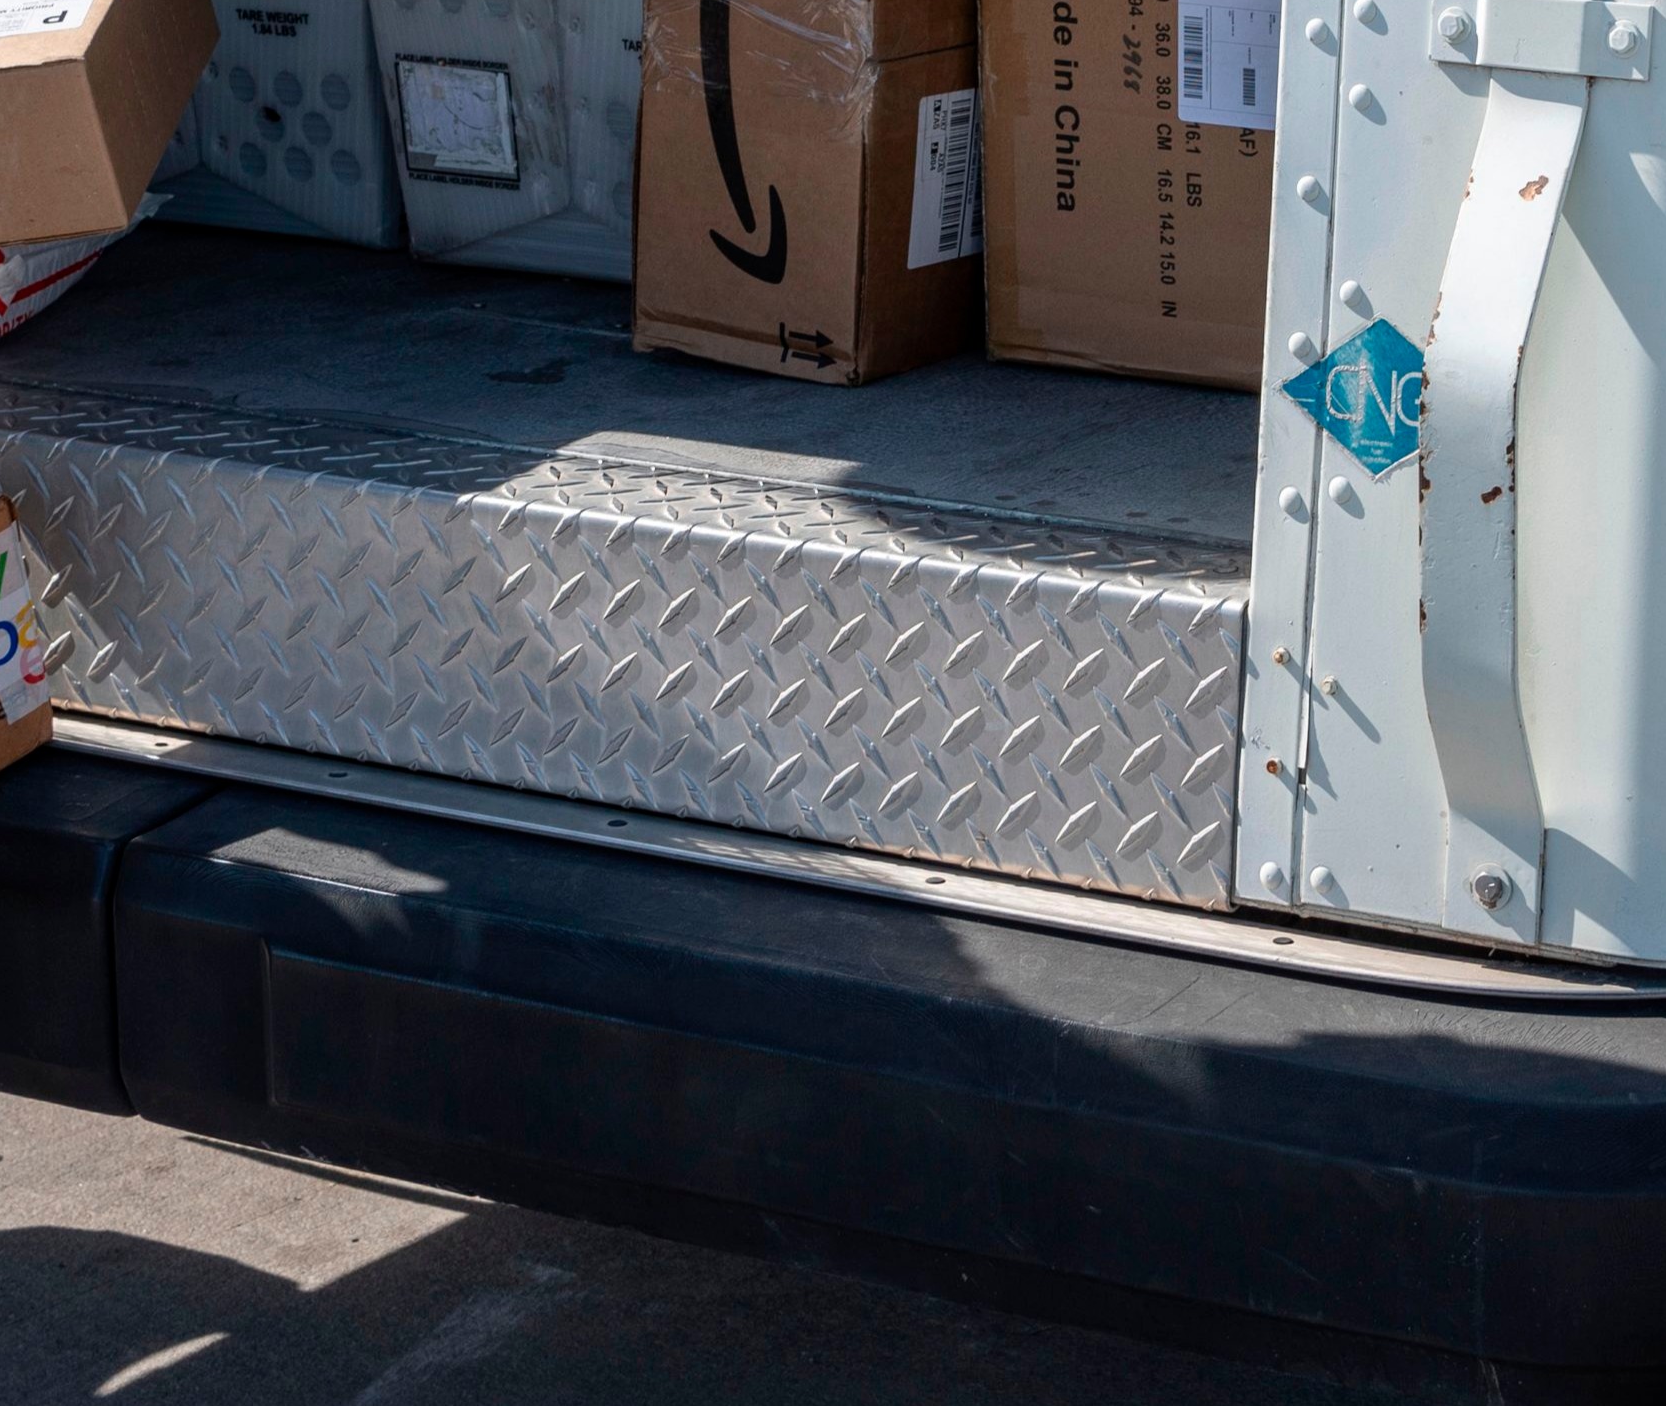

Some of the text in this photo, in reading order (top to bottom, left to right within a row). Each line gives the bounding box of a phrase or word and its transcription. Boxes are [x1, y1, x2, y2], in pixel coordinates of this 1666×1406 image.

[43, 10, 68, 24] P
[236, 8, 309, 25] TARE WEIGHT
[275, 24, 297, 37] LBS
[621, 38, 642, 52] TAR
[1155, 23, 1171, 58] 36.0
[1054, 59, 1078, 91] in
[1156, 75, 1172, 111] 38.0
[1156, 123, 1172, 151] CM
[1054, 105, 1081, 212] China
[1157, 169, 1173, 203] 16.5
[1186, 173, 1202, 208] LBS
[1159, 212, 1175, 246] 14.2
[1160, 252, 1176, 285] 15.0
[1161, 300, 1177, 318] IN
[1326, 364, 1422, 436] CNG
